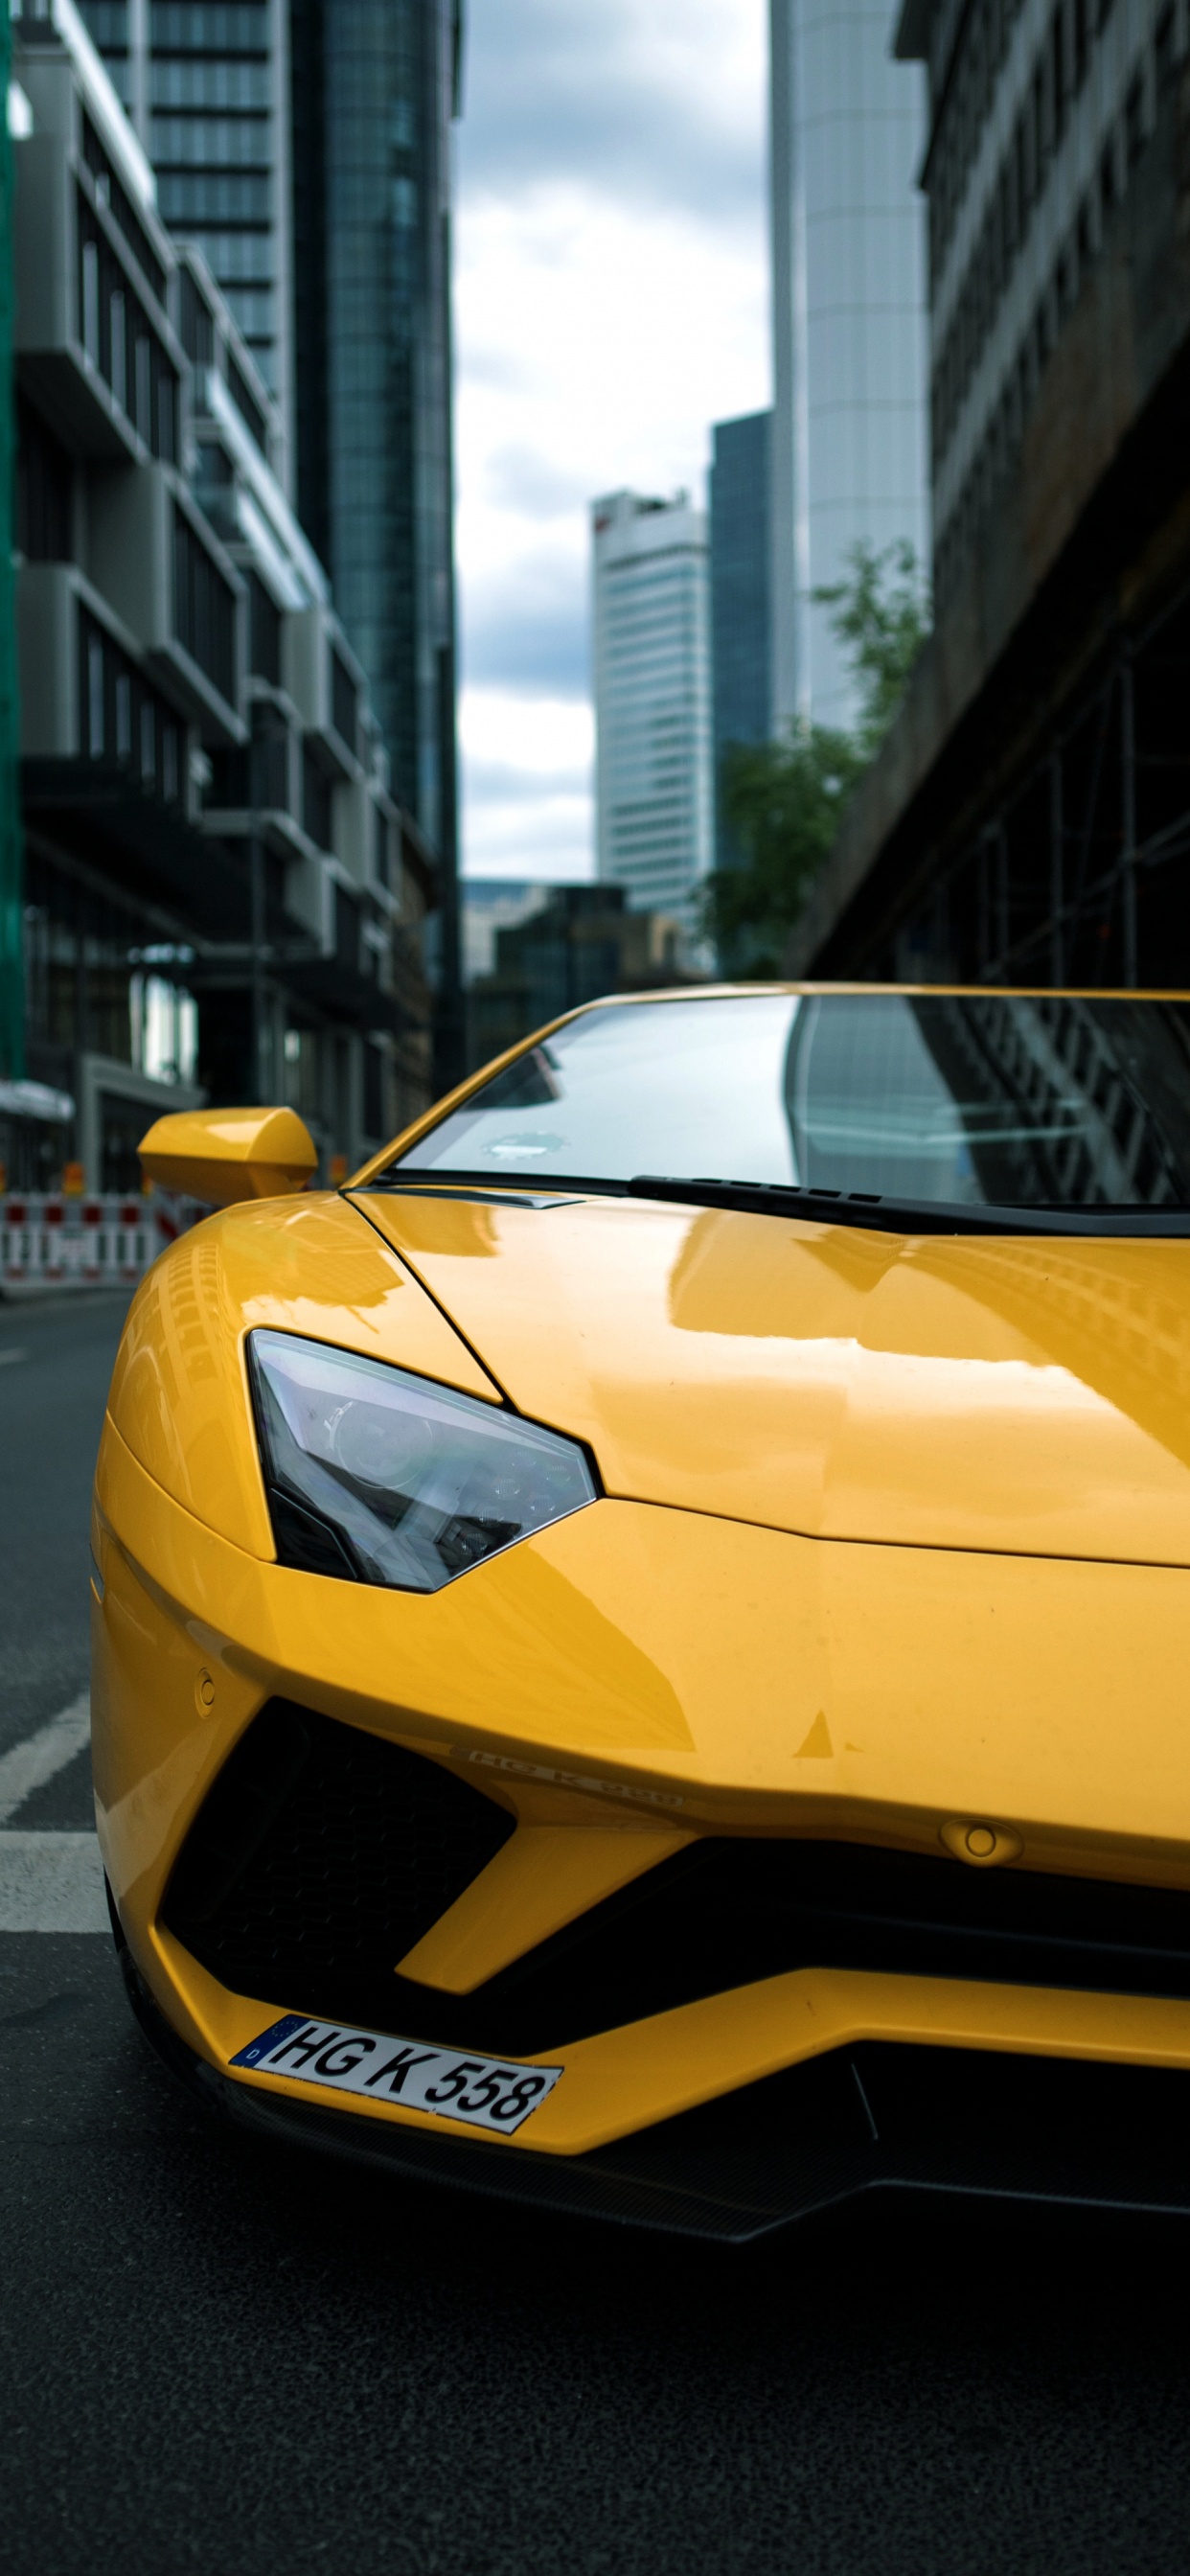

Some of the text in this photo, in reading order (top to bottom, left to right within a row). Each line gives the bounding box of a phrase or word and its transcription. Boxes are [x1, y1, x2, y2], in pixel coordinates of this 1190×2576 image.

[245, 2049, 260, 2059] D
[268, 2027, 546, 2121] HG K 558
